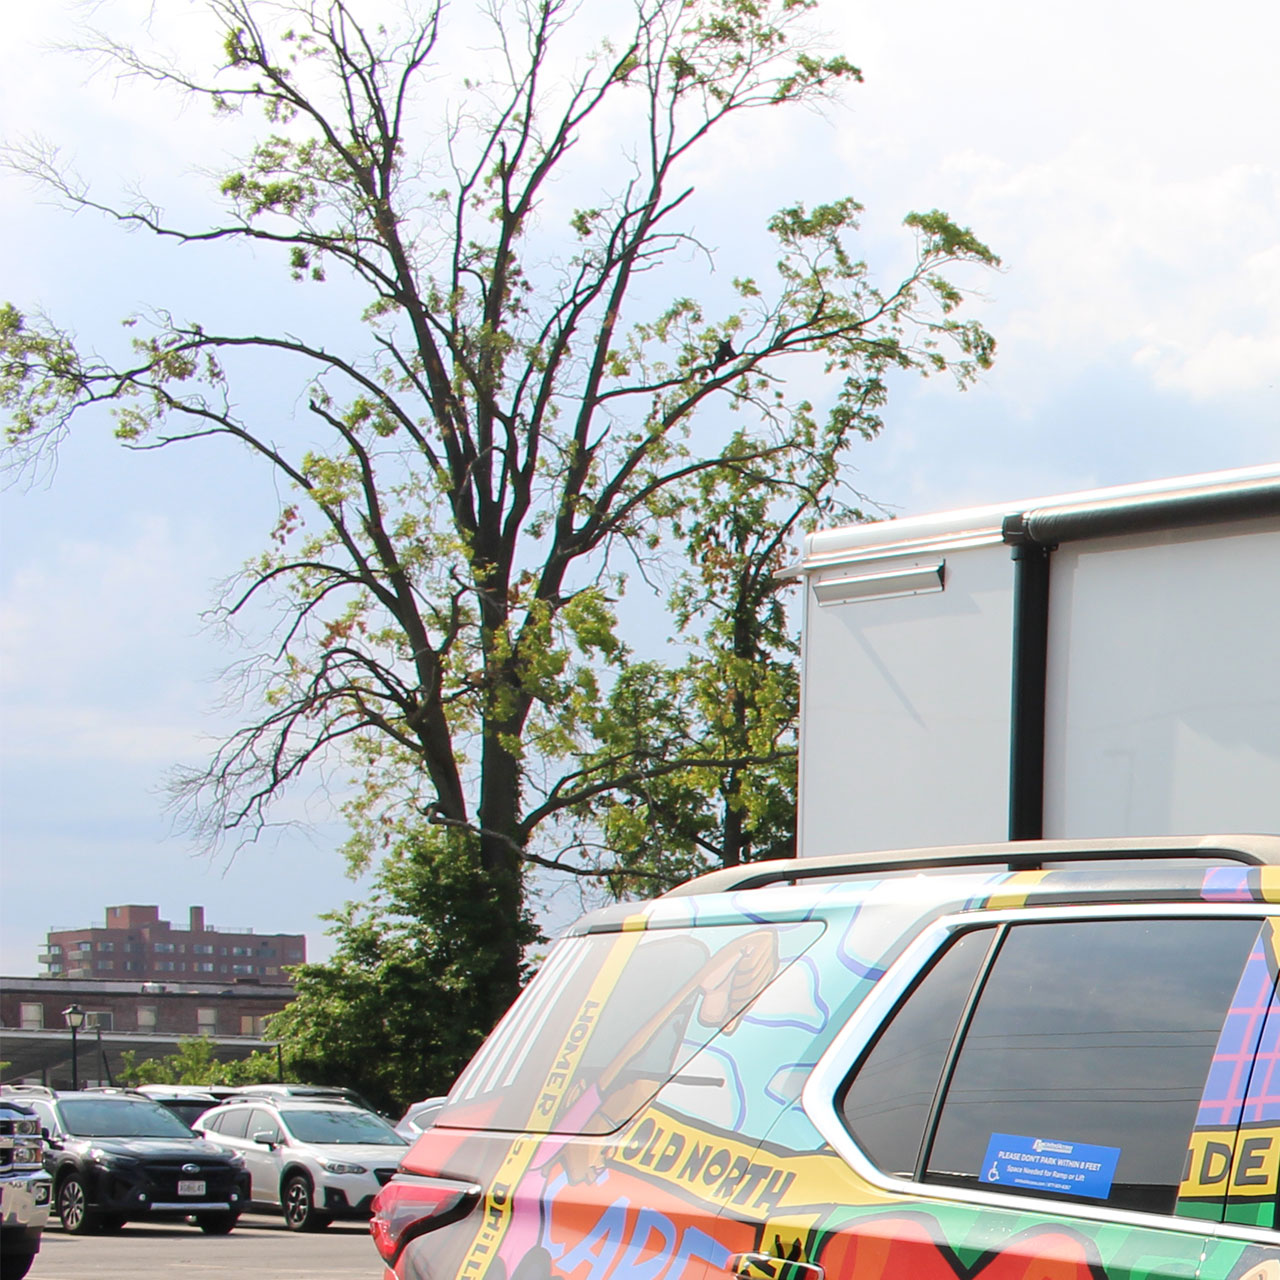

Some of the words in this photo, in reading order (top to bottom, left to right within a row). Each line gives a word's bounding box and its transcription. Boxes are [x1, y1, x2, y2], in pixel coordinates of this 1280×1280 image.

[537, 999, 602, 1119] HOMER
[622, 1117, 686, 1173] OLD
[676, 1140, 797, 1210] NORTH
[998, 1150, 1021, 1161] PLEASE
[1021, 1153, 1041, 1164] DON'T
[1040, 1156, 1058, 1167] PARK
[1057, 1159, 1081, 1170] WITHIN
[1084, 1162, 1102, 1172] FEET
[1006, 1164, 1023, 1174] Space
[1023, 1167, 1044, 1177] Needed
[1044, 1170, 1052, 1178] for
[1052, 1171, 1069, 1181] Ramp
[1075, 1174, 1086, 1182] Lift
